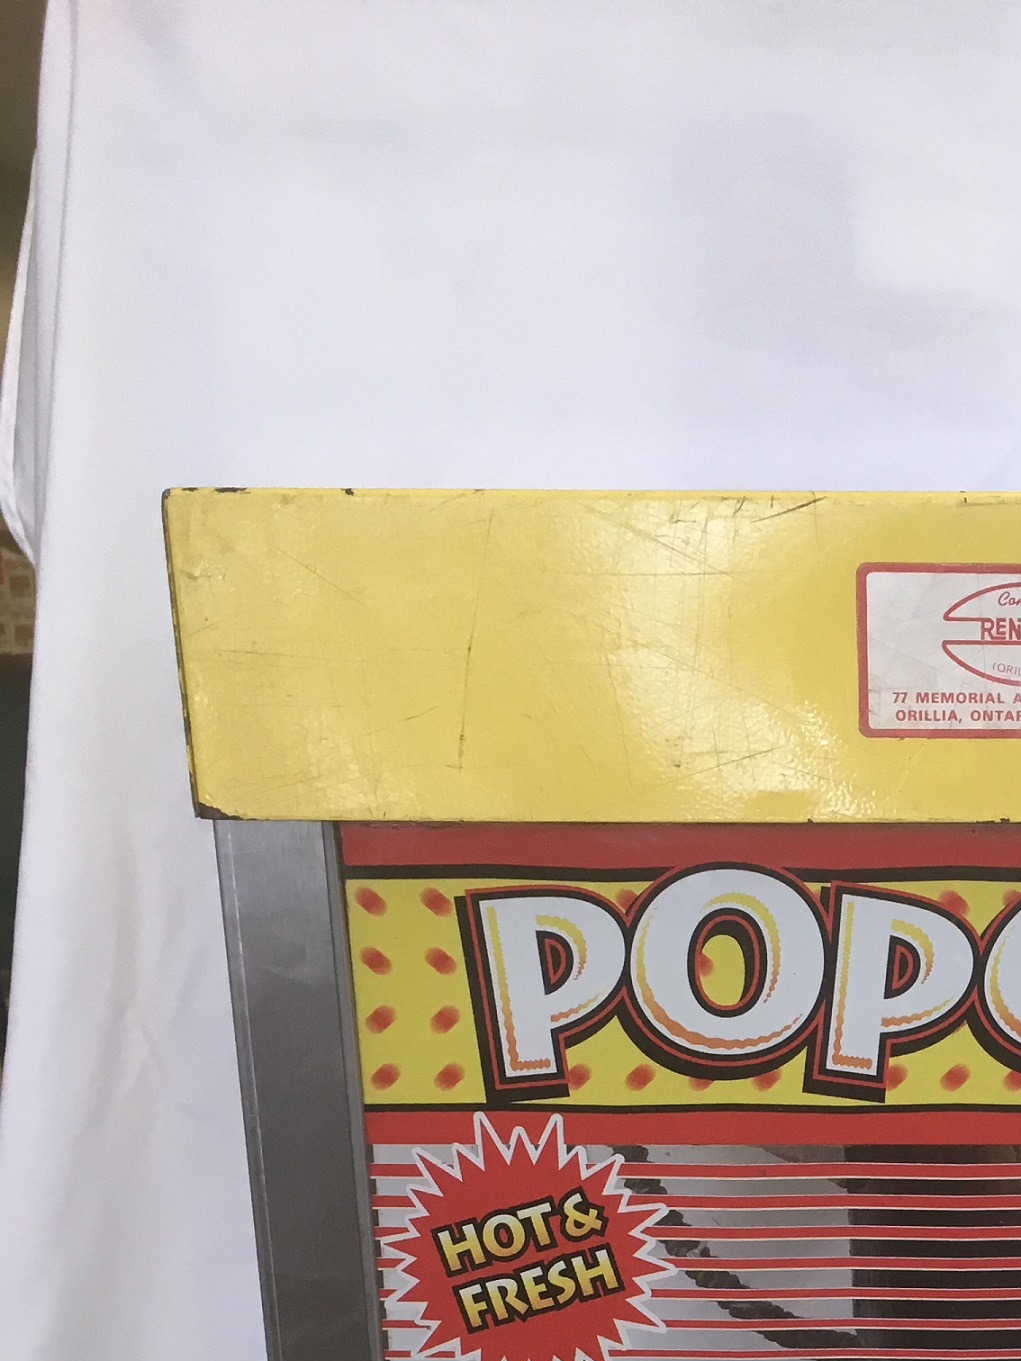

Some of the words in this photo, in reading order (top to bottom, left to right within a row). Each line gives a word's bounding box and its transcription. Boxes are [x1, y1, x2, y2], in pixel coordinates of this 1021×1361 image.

[892, 691, 908, 704] 77
[915, 691, 1006, 704] MEMORIAL
[895, 709, 963, 723] ORILLIA,
[433, 1196, 551, 1274] HOT
[555, 1187, 608, 1243] &
[454, 1247, 624, 1332] FRESH
